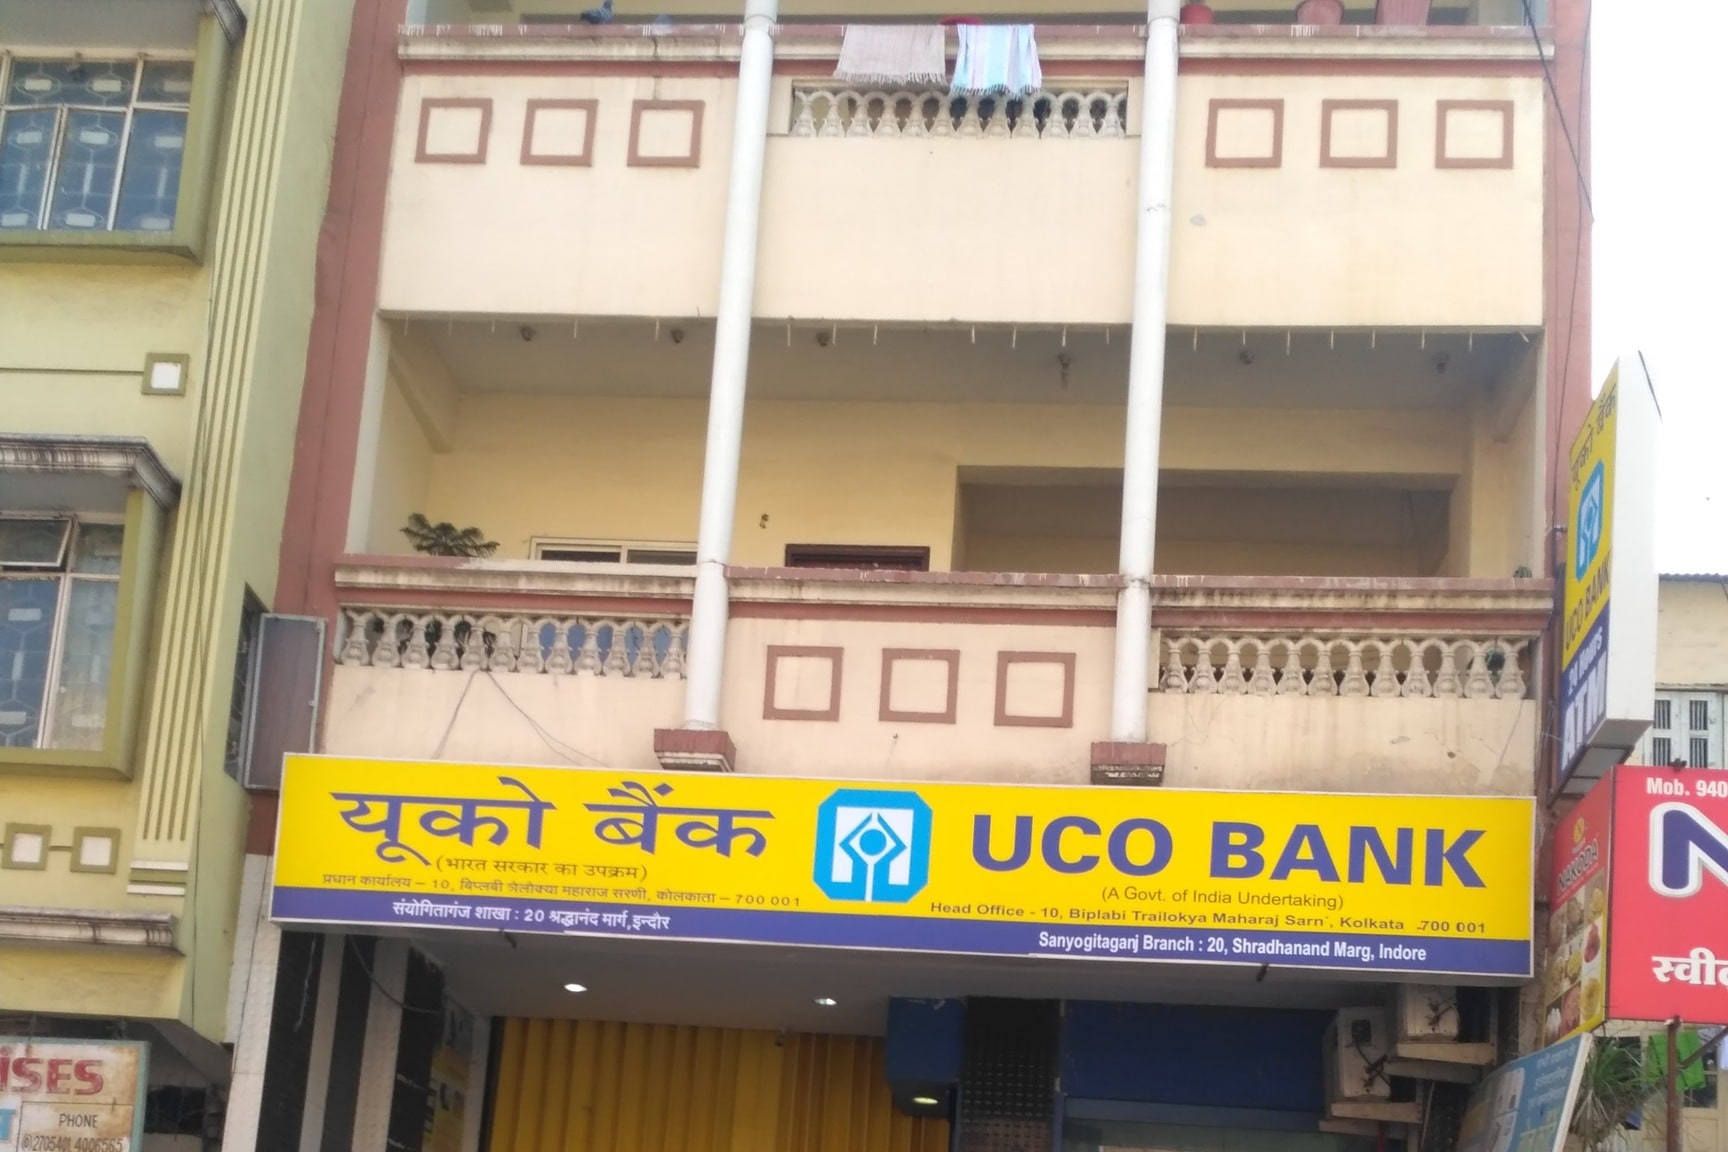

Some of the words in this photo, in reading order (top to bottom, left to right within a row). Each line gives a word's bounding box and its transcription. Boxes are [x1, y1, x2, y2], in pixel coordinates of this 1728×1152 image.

[1561, 651, 1608, 772] ATM
[1646, 776, 1691, 796] Mob.
[329, 775, 557, 867] यूको
[584, 780, 775, 858] बैंक
[970, 814, 1174, 877] UCO
[1209, 820, 1489, 889] BANK
[436, 855, 487, 873] (भारत
[493, 859, 548, 875] सरकार
[554, 863, 578, 877] का
[583, 863, 648, 883] उपक्रम)
[322, 873, 356, 886] प्रधान
[562, 885, 609, 899] महाराज
[656, 888, 716, 904] कोलकाता
[735, 893, 765, 905] 700
[770, 895, 801, 908] 001
[1102, 886, 1120, 904] (A
[1124, 886, 1165, 902] Govt.
[1172, 888, 1188, 903] of
[1193, 889, 1232, 905] India
[1237, 890, 1344, 911] Undertaking)
[392, 897, 471, 920] संयोगितागंज
[475, 905, 511, 921] शाखा
[524, 908, 545, 923] 20
[930, 902, 972, 915] Head
[976, 903, 1025, 918] Office
[1041, 907, 1064, 920] 10,
[1069, 907, 1126, 924] Biplabi
[1131, 910, 1207, 926] Trailokya
[1212, 912, 1279, 928] Maharaj
[1339, 916, 1405, 931] Kolkata
[1455, 921, 1486, 934] 001
[1039, 930, 1140, 952] Sanyogitaganj
[1143, 933, 1195, 952] Branch
[1207, 936, 1229, 955] 20,
[1232, 936, 1330, 957] Shradhanand
[1334, 941, 1375, 962] Marg,
[1379, 943, 1427, 961] Indore
[1651, 946, 1728, 986] स्वी
[58, 1113, 99, 1129] PHONE
